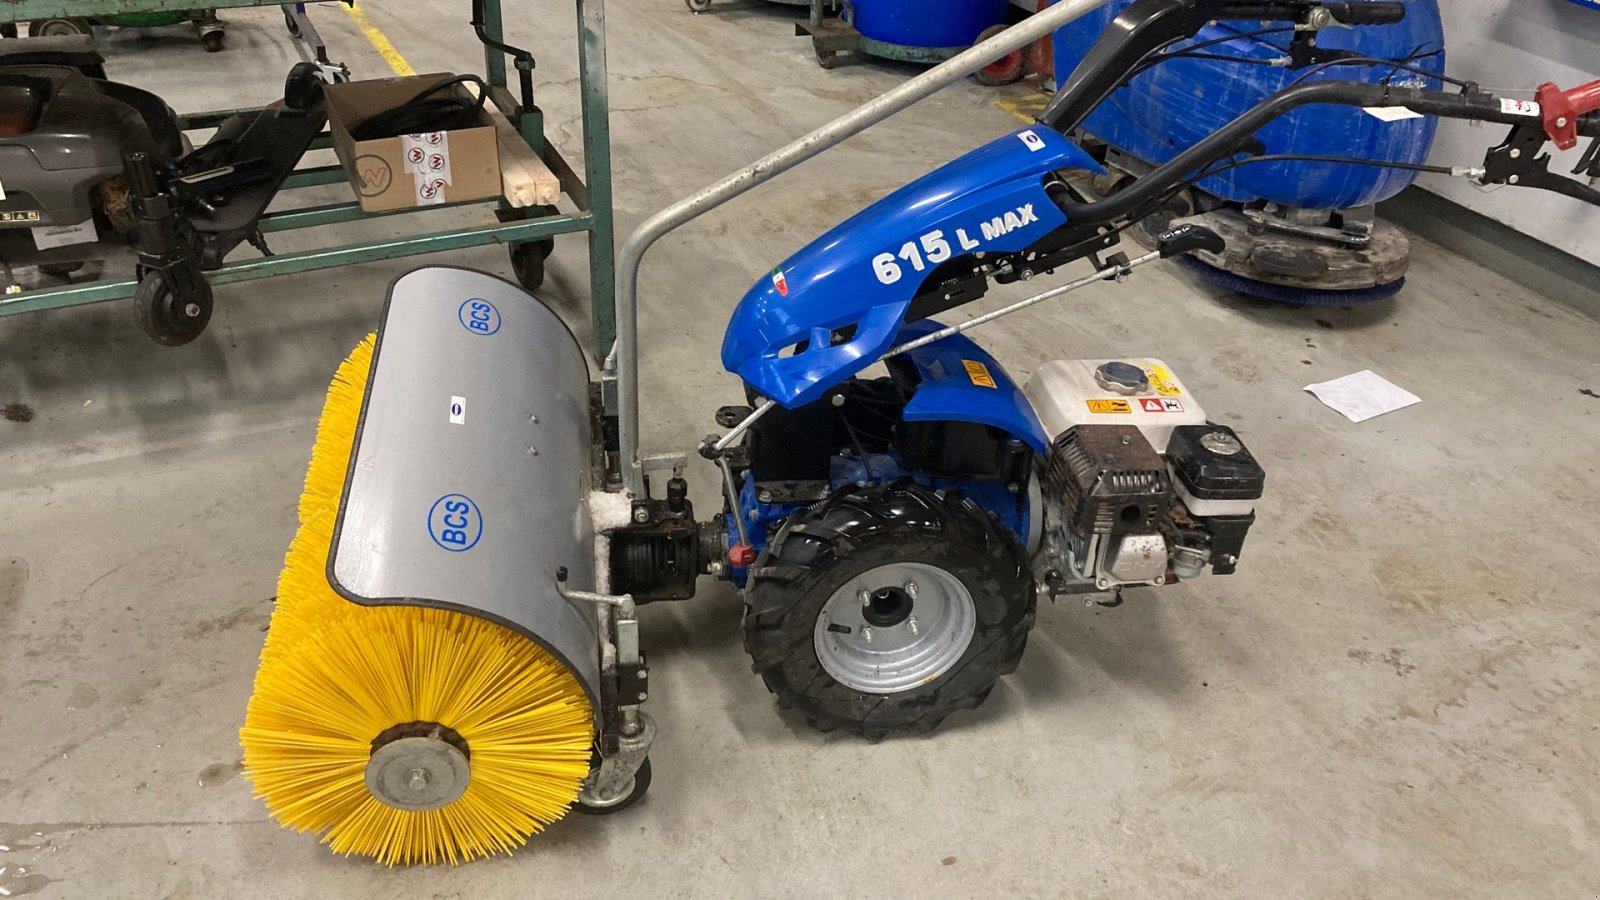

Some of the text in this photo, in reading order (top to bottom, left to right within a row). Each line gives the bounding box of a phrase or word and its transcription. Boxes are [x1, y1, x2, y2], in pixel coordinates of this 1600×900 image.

[872, 204, 1038, 285] 615 L MAX
[469, 302, 491, 332] BCS
[442, 500, 470, 545] BCS
